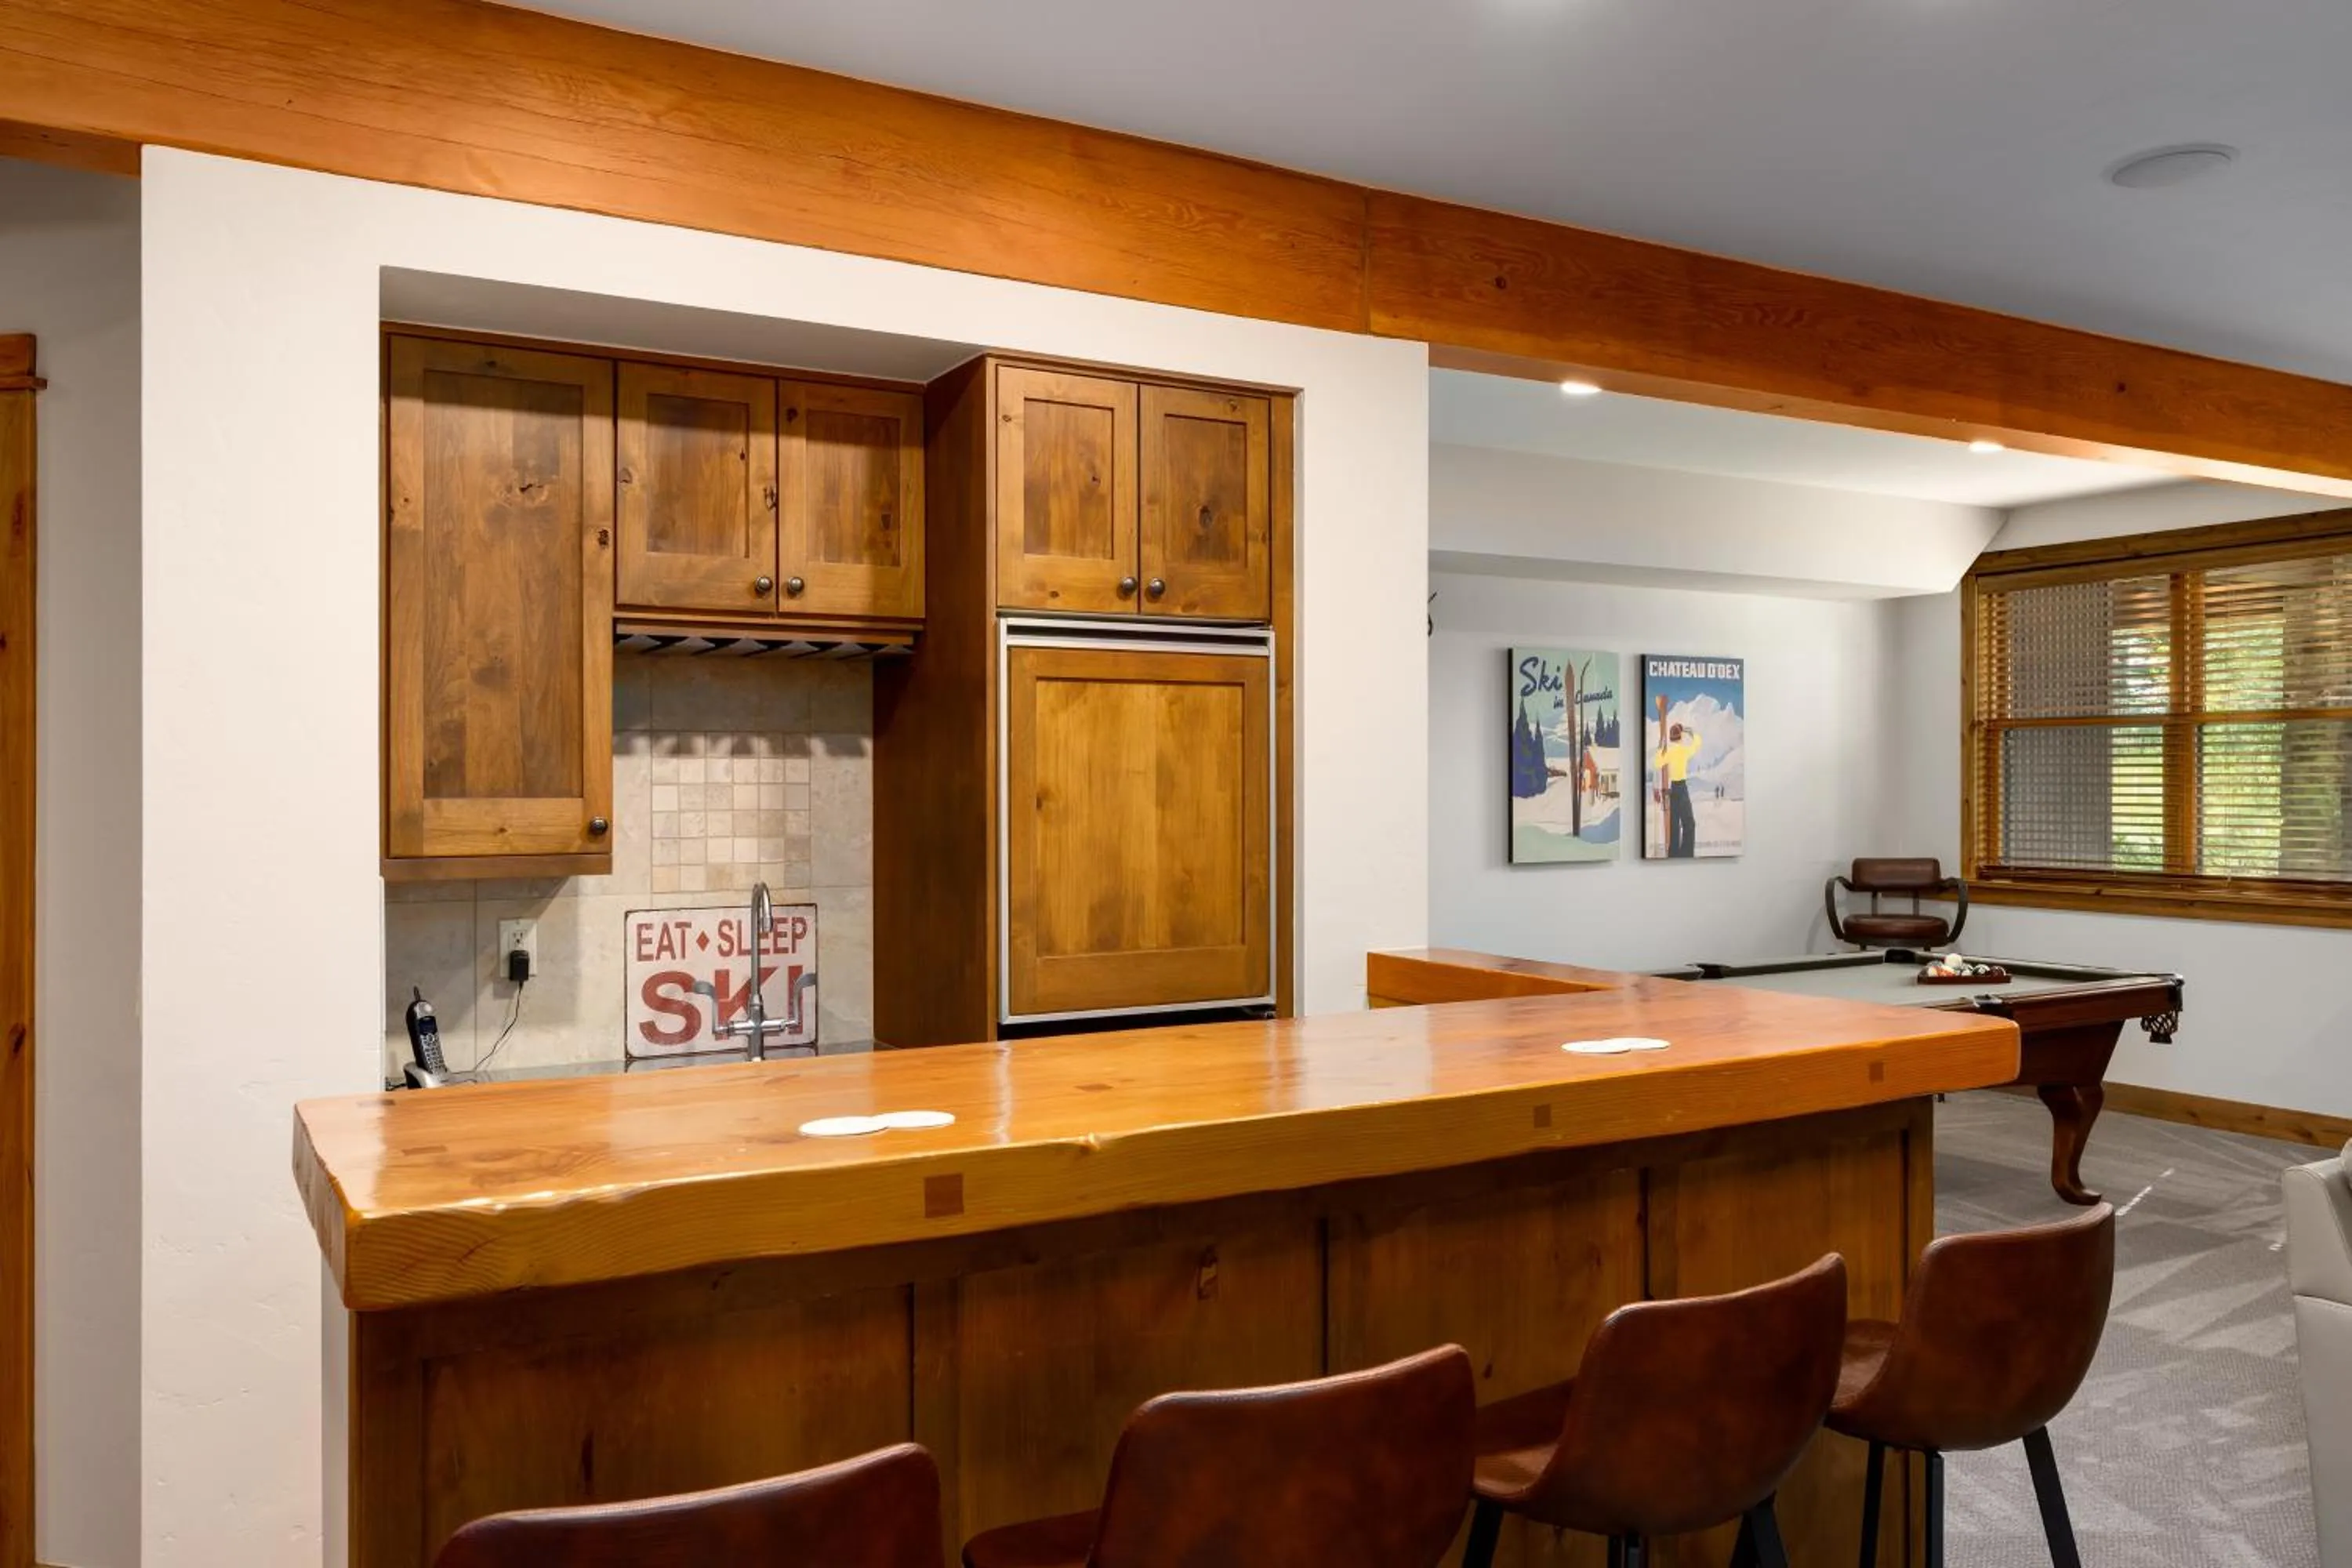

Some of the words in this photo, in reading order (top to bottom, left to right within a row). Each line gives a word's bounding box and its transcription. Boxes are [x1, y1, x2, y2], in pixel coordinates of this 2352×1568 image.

[1519, 656, 1563, 697] Ski
[1649, 661, 1706, 678] CHATEAU
[1553, 695, 1564, 709] in
[636, 921, 692, 962] EAT
[639, 964, 804, 1046] SKI
